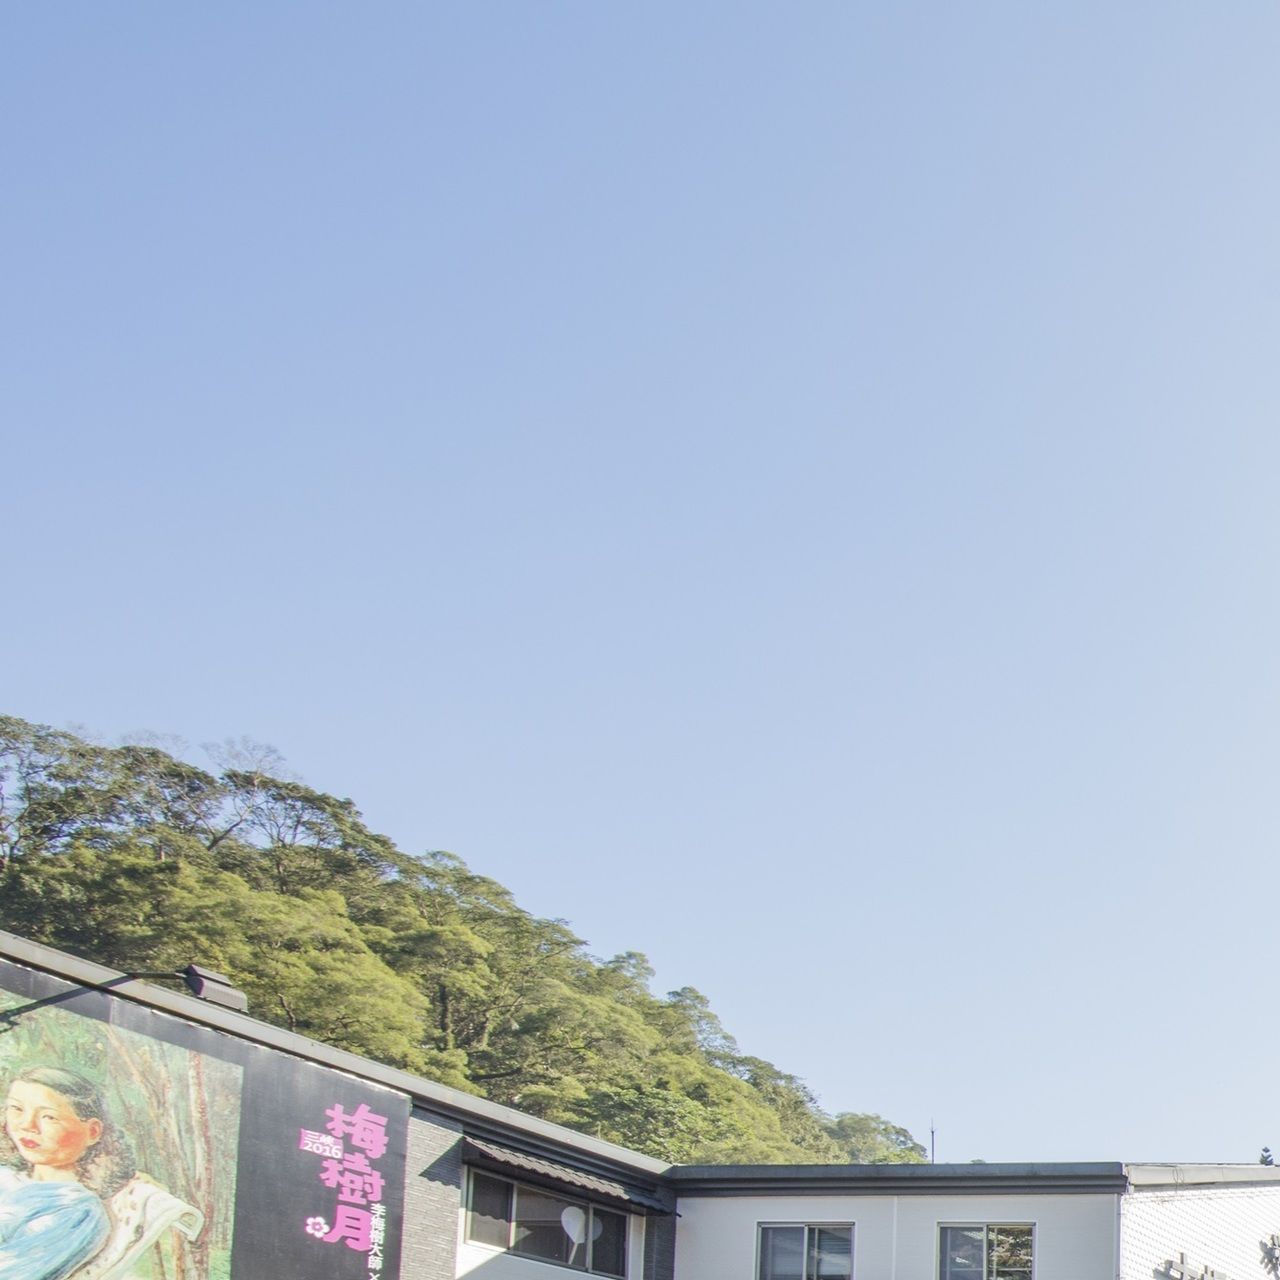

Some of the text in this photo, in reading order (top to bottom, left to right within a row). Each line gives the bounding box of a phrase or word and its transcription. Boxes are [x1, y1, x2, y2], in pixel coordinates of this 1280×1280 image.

[303, 1140, 341, 1159] 2016
[319, 1103, 389, 1252] 梅樹月
